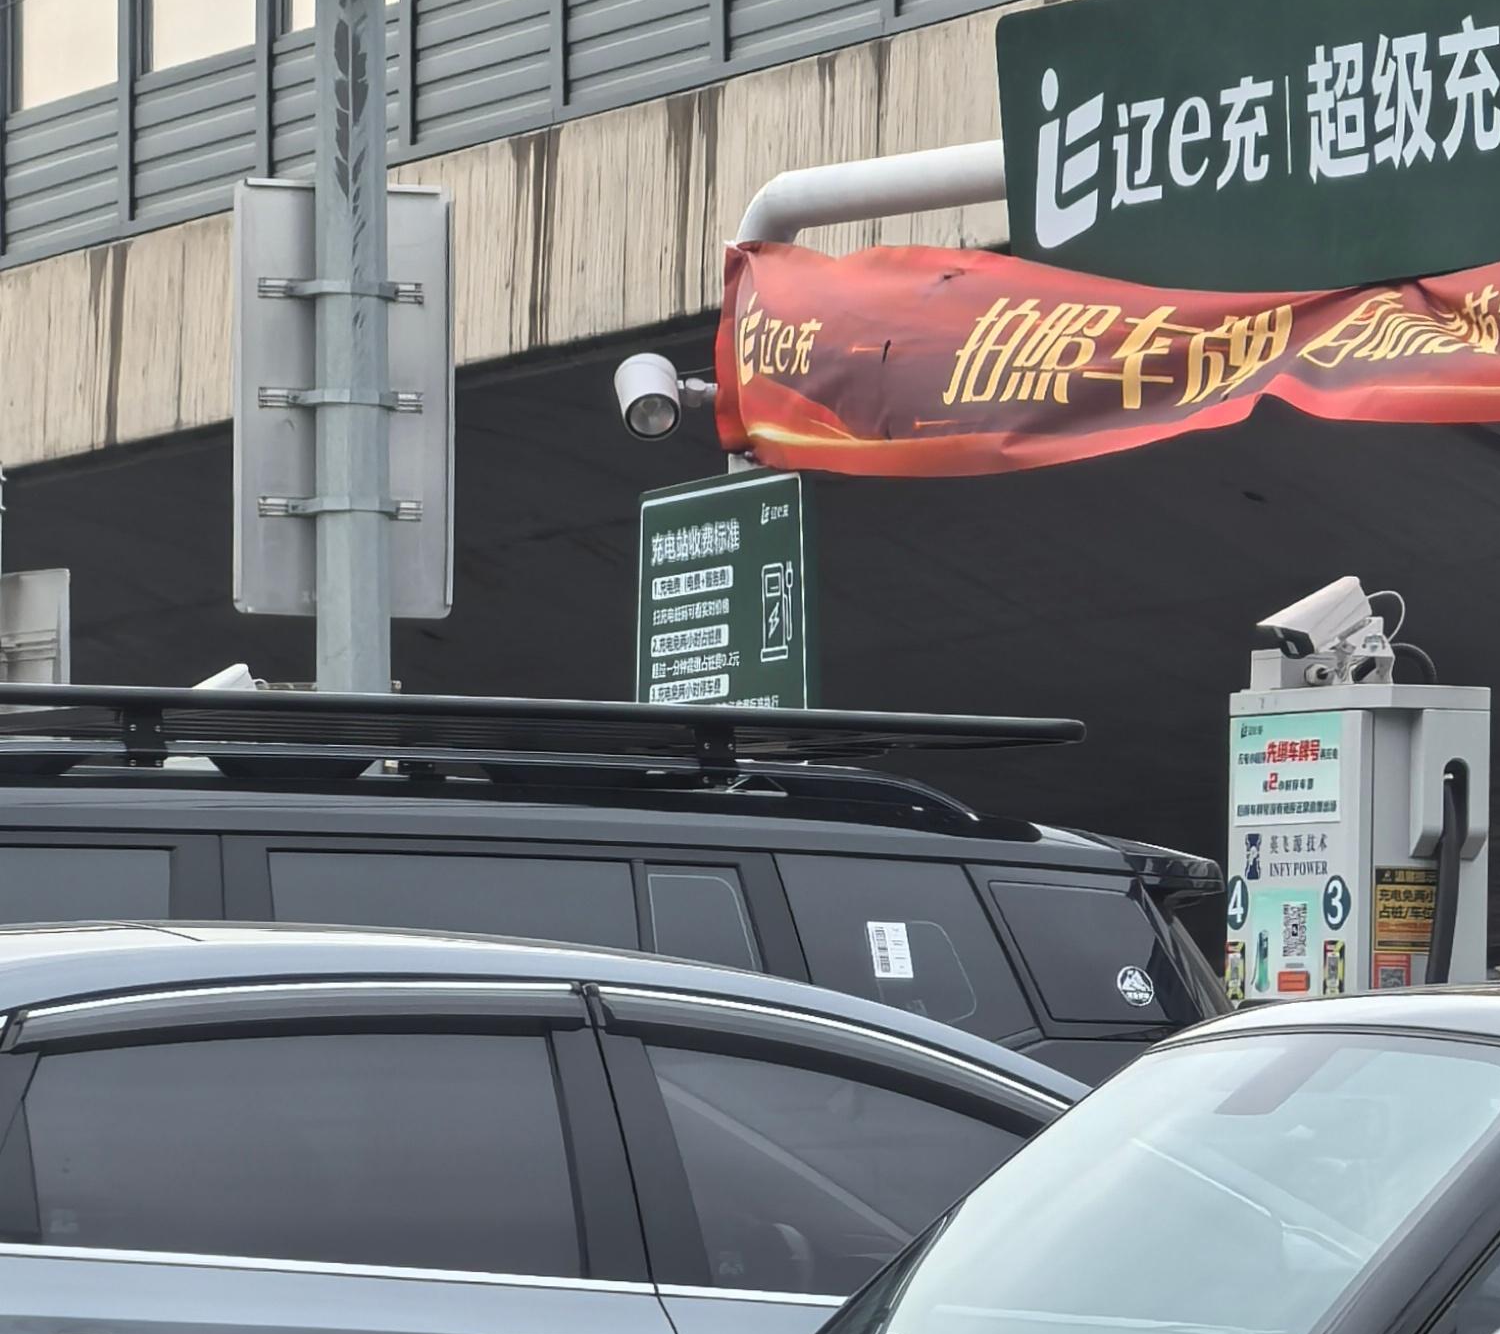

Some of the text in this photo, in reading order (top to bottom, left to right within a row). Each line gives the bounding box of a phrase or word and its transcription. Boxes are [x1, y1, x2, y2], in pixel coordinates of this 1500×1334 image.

[942, 297, 1294, 410] 拍照车牌
[651, 518, 740, 566] 充电站收费标准
[1228, 879, 1244, 923] 4
[1327, 879, 1344, 925] 3
